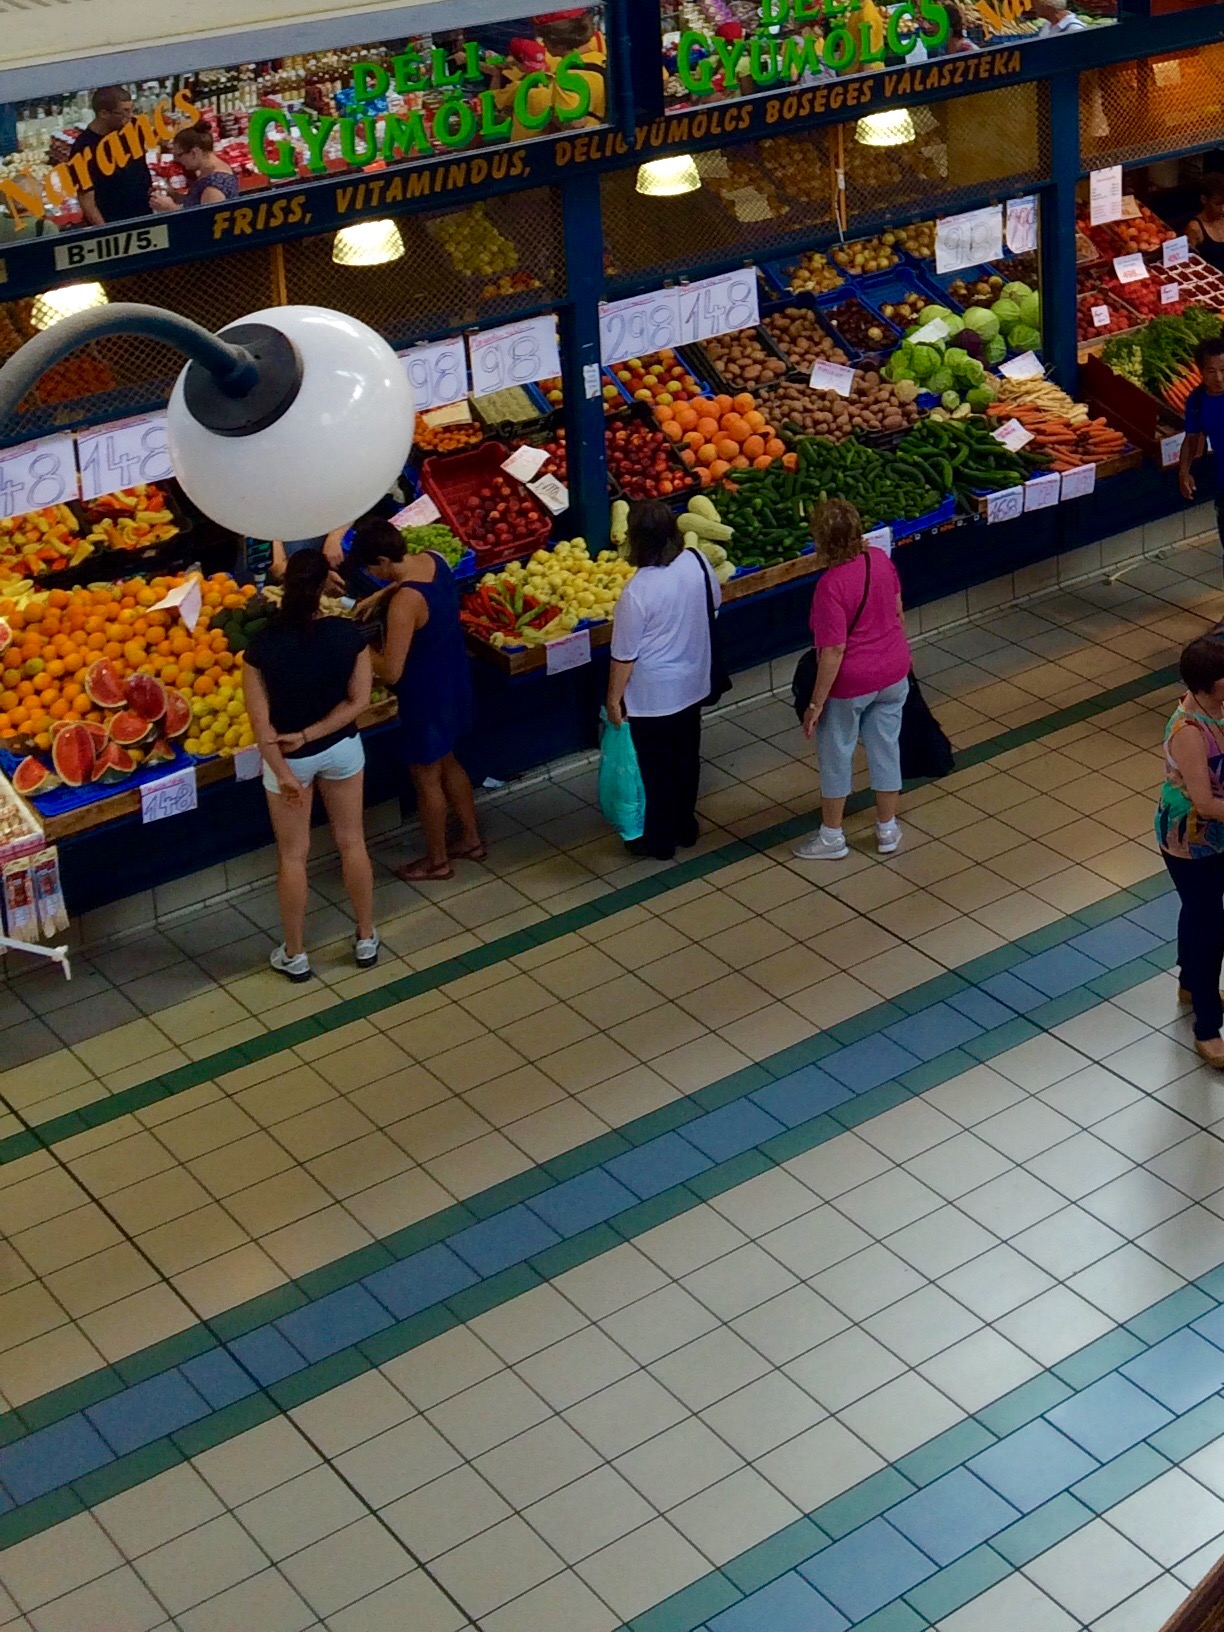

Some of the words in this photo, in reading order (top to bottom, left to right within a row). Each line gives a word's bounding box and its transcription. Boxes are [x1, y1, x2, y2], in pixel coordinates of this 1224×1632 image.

[352, 41, 506, 103] DÉLI-
[212, 195, 312, 240] FRISS,
[883, 49, 1022, 98] VÁLASZTÉKA
[248, 50, 592, 179] GYÜMÖLCS
[0, 88, 200, 232] Narancs
[67, 232, 159, 266] B-III/5.
[606, 304, 675, 364] 298
[685, 280, 755, 341] 148
[478, 335, 541, 393] 98
[82, 426, 174, 496] 148
